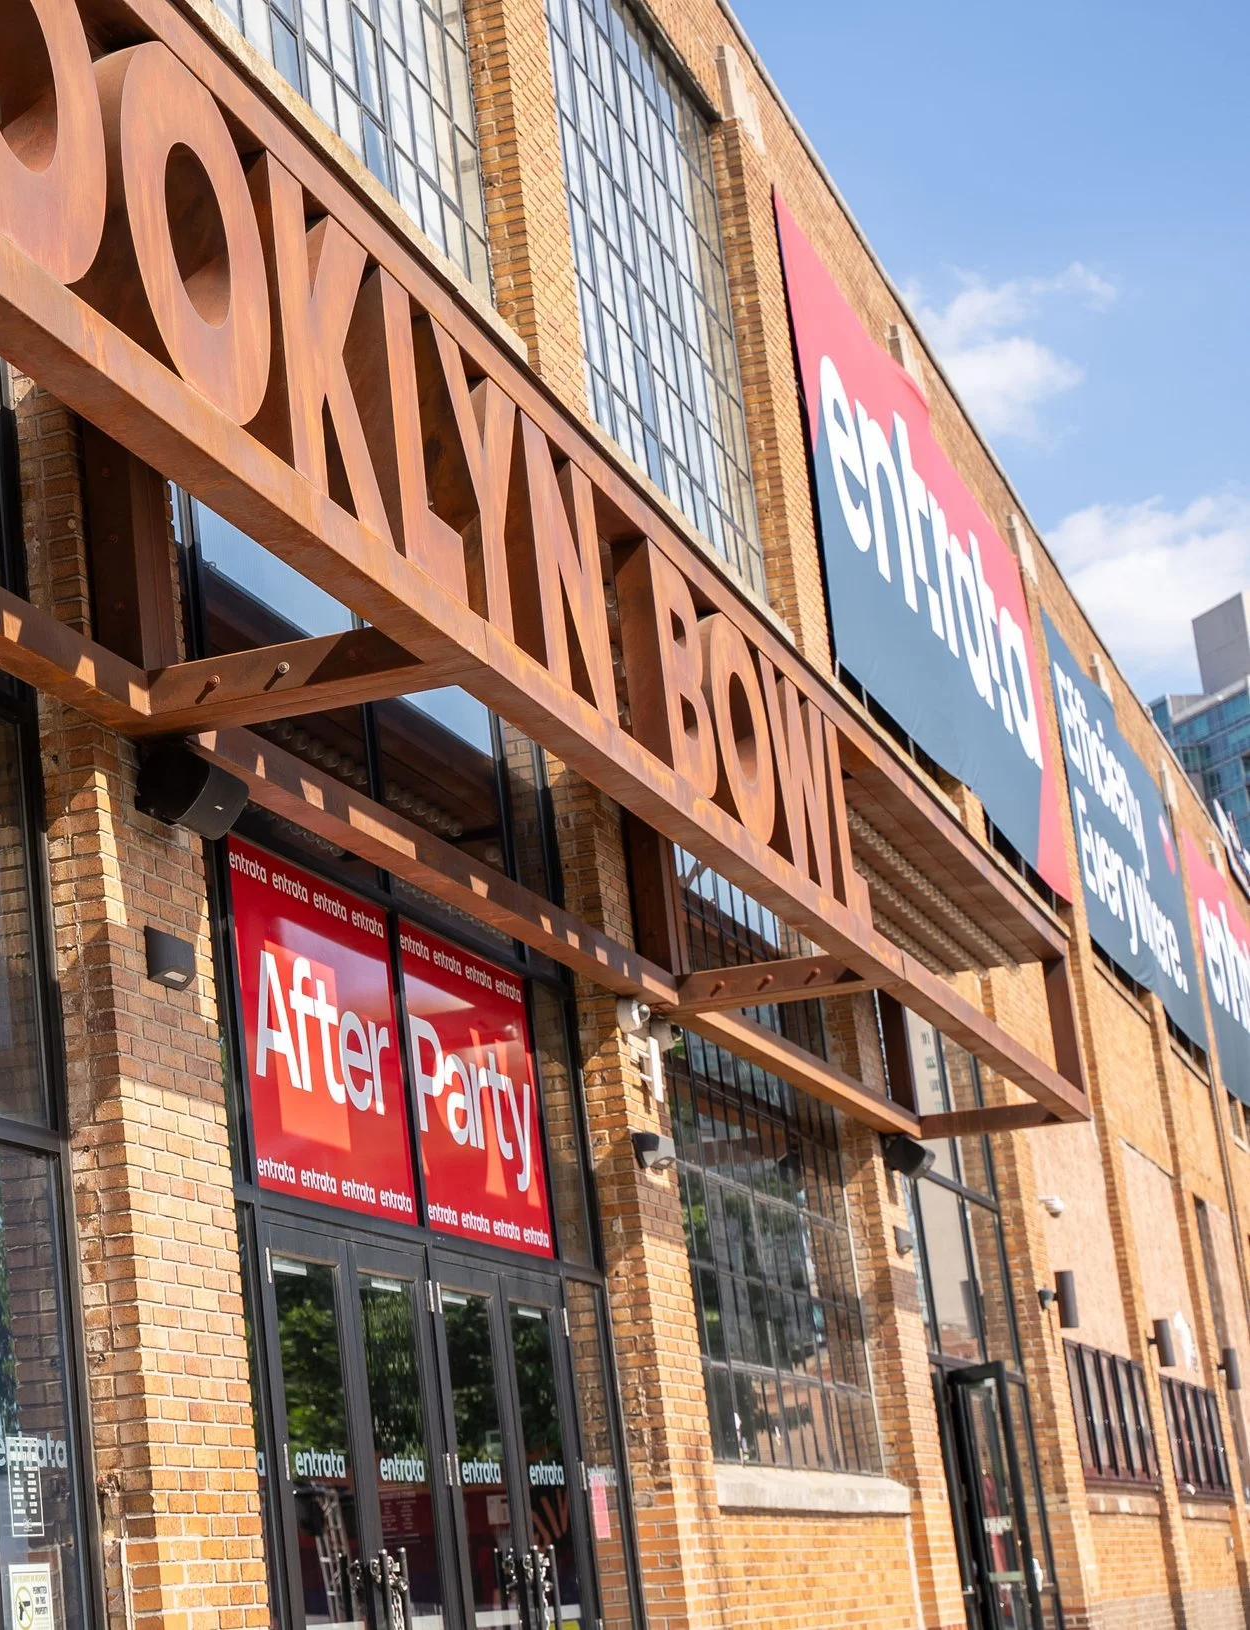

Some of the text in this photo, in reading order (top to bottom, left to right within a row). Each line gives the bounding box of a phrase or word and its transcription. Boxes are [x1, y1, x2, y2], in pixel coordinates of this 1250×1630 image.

[820, 355, 1043, 770] entrata
[647, 536, 874, 931] BOWL
[229, 851, 384, 938] entrata entrata entrata entrata
[400, 932, 521, 1004] entrata entrata entrata entrata
[256, 950, 390, 1116] After
[408, 1013, 530, 1192] Party
[257, 1156, 412, 1213] entrata entrata entrata entrata
[428, 1203, 550, 1249] entrata entrata entrata entrata
[295, 1447, 347, 1478] entrata
[380, 1453, 426, 1482] entrata
[461, 1456, 502, 1485] entrata
[530, 1460, 565, 1485] entrata
